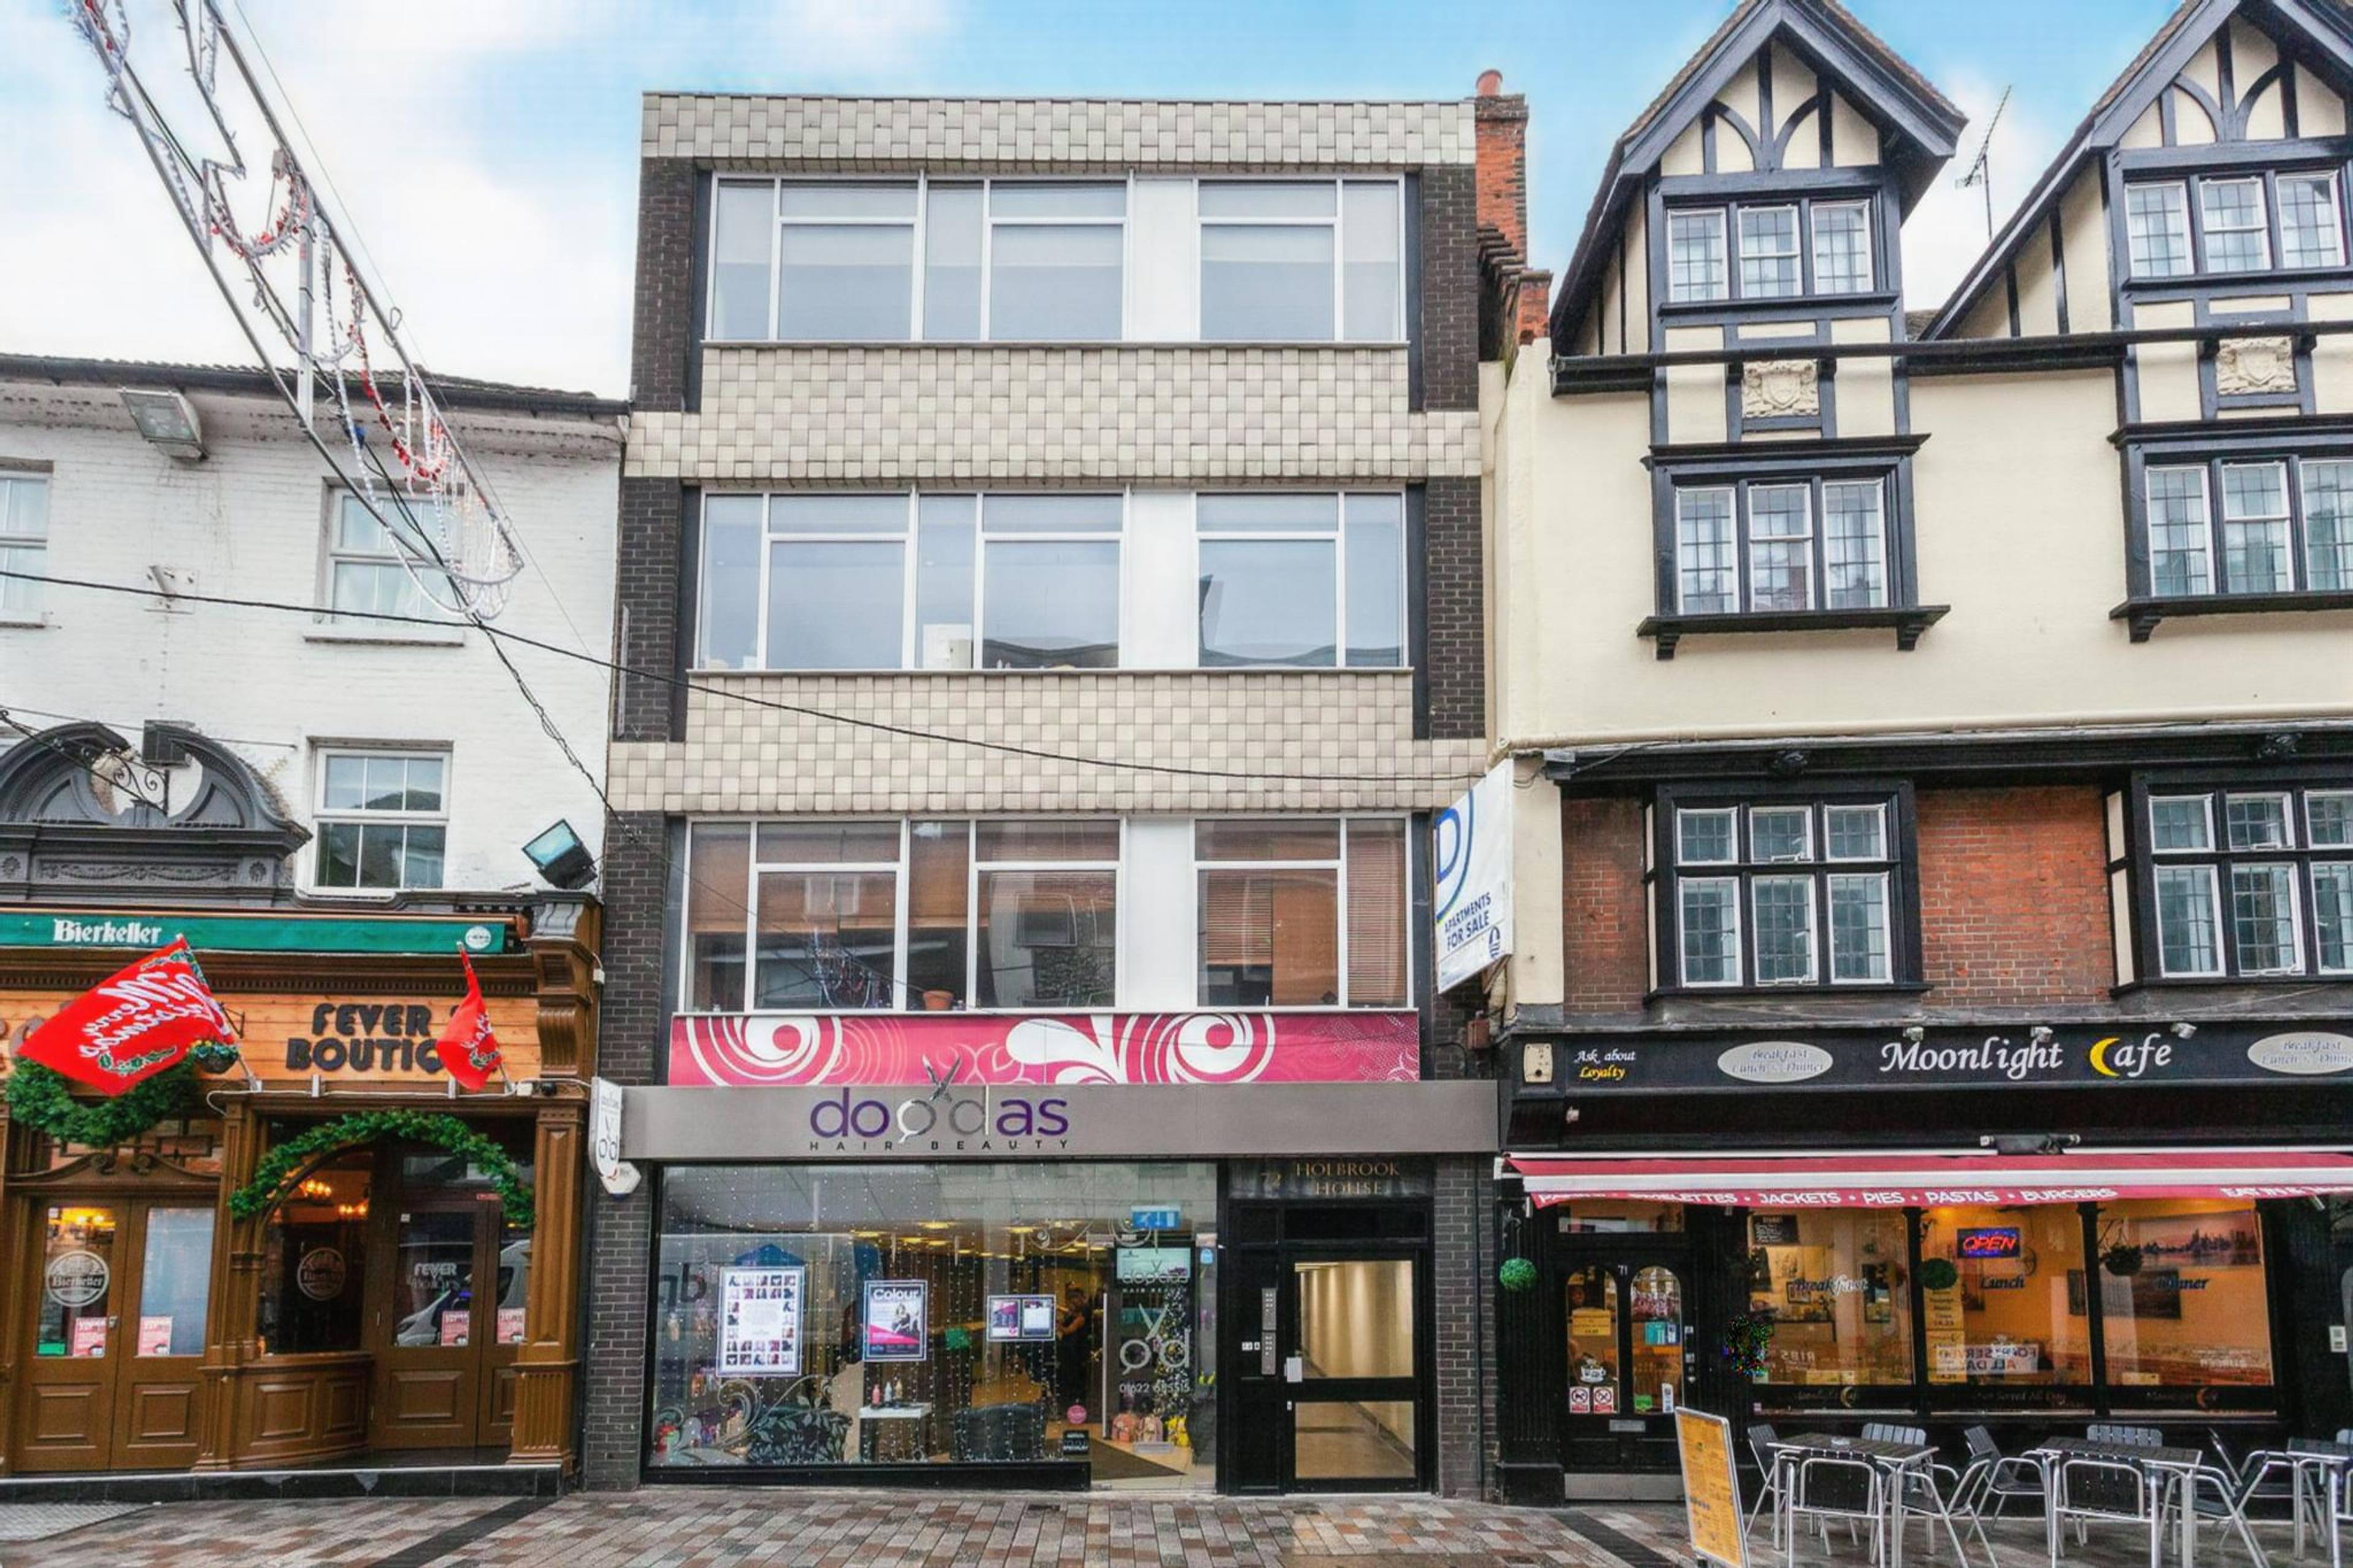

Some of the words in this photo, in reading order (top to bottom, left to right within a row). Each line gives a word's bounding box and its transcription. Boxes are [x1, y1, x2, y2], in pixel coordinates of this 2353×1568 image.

[1444, 892, 1491, 933] APARTMENTS
[53, 918, 162, 944] Bierkeller
[1447, 926, 1463, 951] FOR
[1466, 911, 1490, 937] SALE
[312, 1003, 432, 1037] FEVER
[286, 1038, 445, 1074] BOUTIQ
[1574, 1049, 1601, 1064] Ask
[1604, 1048, 1637, 1061] about
[1879, 1036, 2064, 1080] Moonlight
[2319, 1054, 2353, 1064] Dinn
[1579, 1065, 1626, 1081] Loyalty
[809, 1140, 893, 1151] HAIR
[931, 1139, 1067, 1151] BEAUTY
[1297, 1162, 1399, 1177] HOLBROOK
[1316, 1181, 1382, 1195] HOUSE
[1759, 1192, 1841, 1205] JACKETS
[1862, 1191, 1905, 1205] PIES
[1925, 1191, 1999, 1205] PASTAS
[2020, 1187, 2118, 1202] BURGERS
[1963, 1235, 2017, 1251] OPEN
[414, 1262, 458, 1280] FEVER
[873, 1288, 919, 1300] Colour
[1119, 1382, 1150, 1393] 01622
